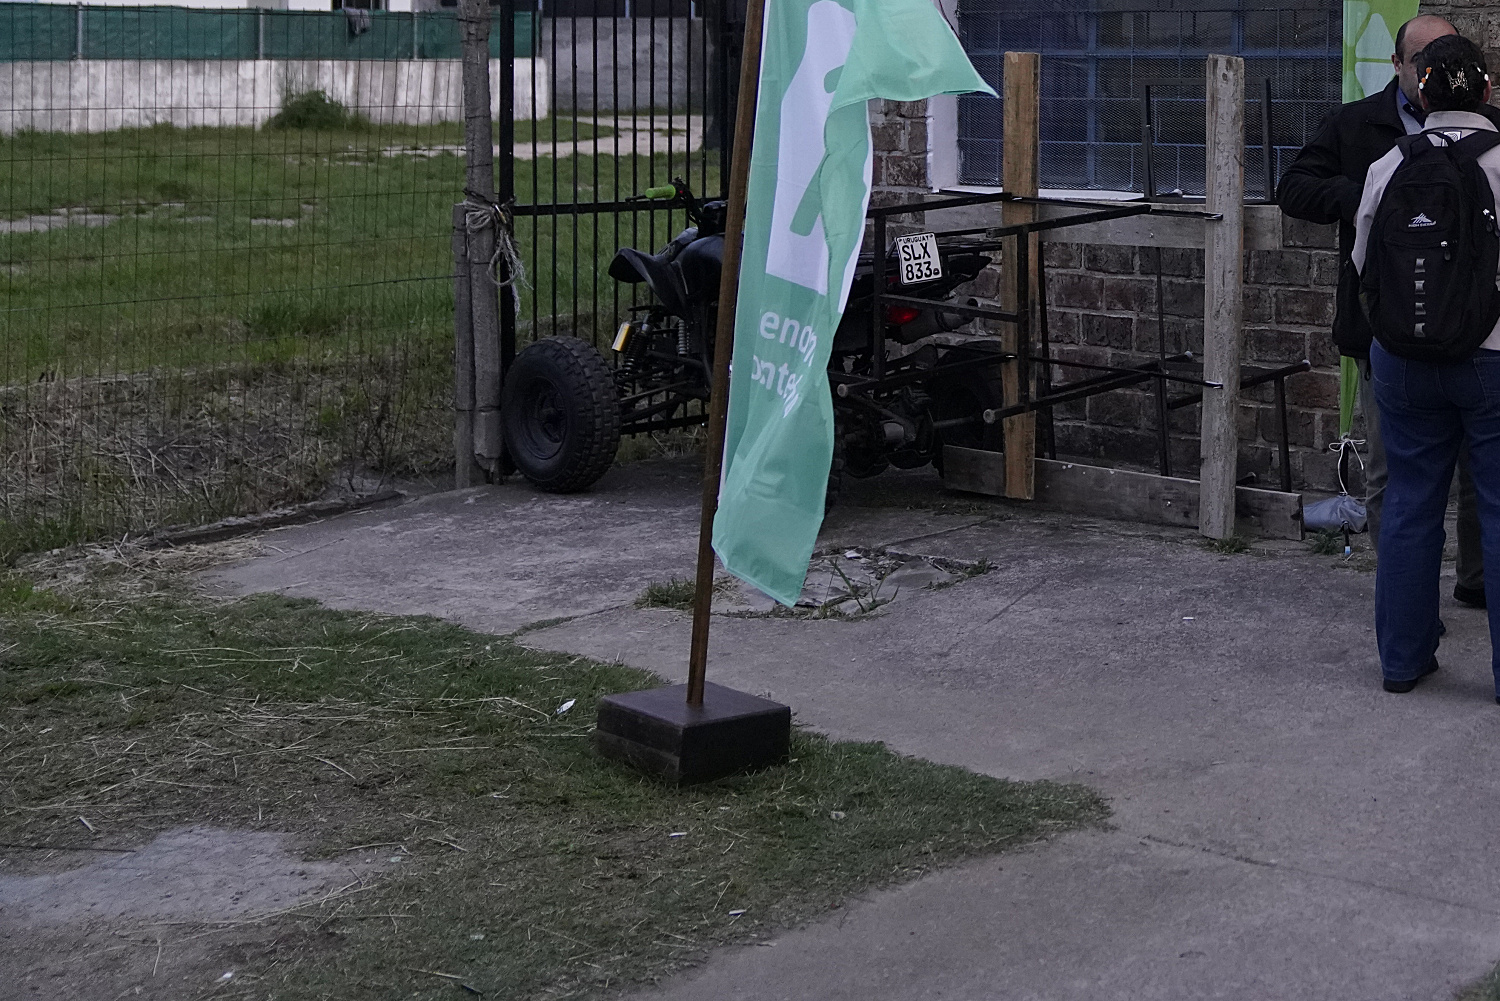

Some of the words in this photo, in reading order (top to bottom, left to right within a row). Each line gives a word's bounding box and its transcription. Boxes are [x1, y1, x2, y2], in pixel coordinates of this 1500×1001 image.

[903, 234, 929, 244] URUGUAY
[902, 242, 931, 262] SLX
[905, 261, 933, 281] 833
